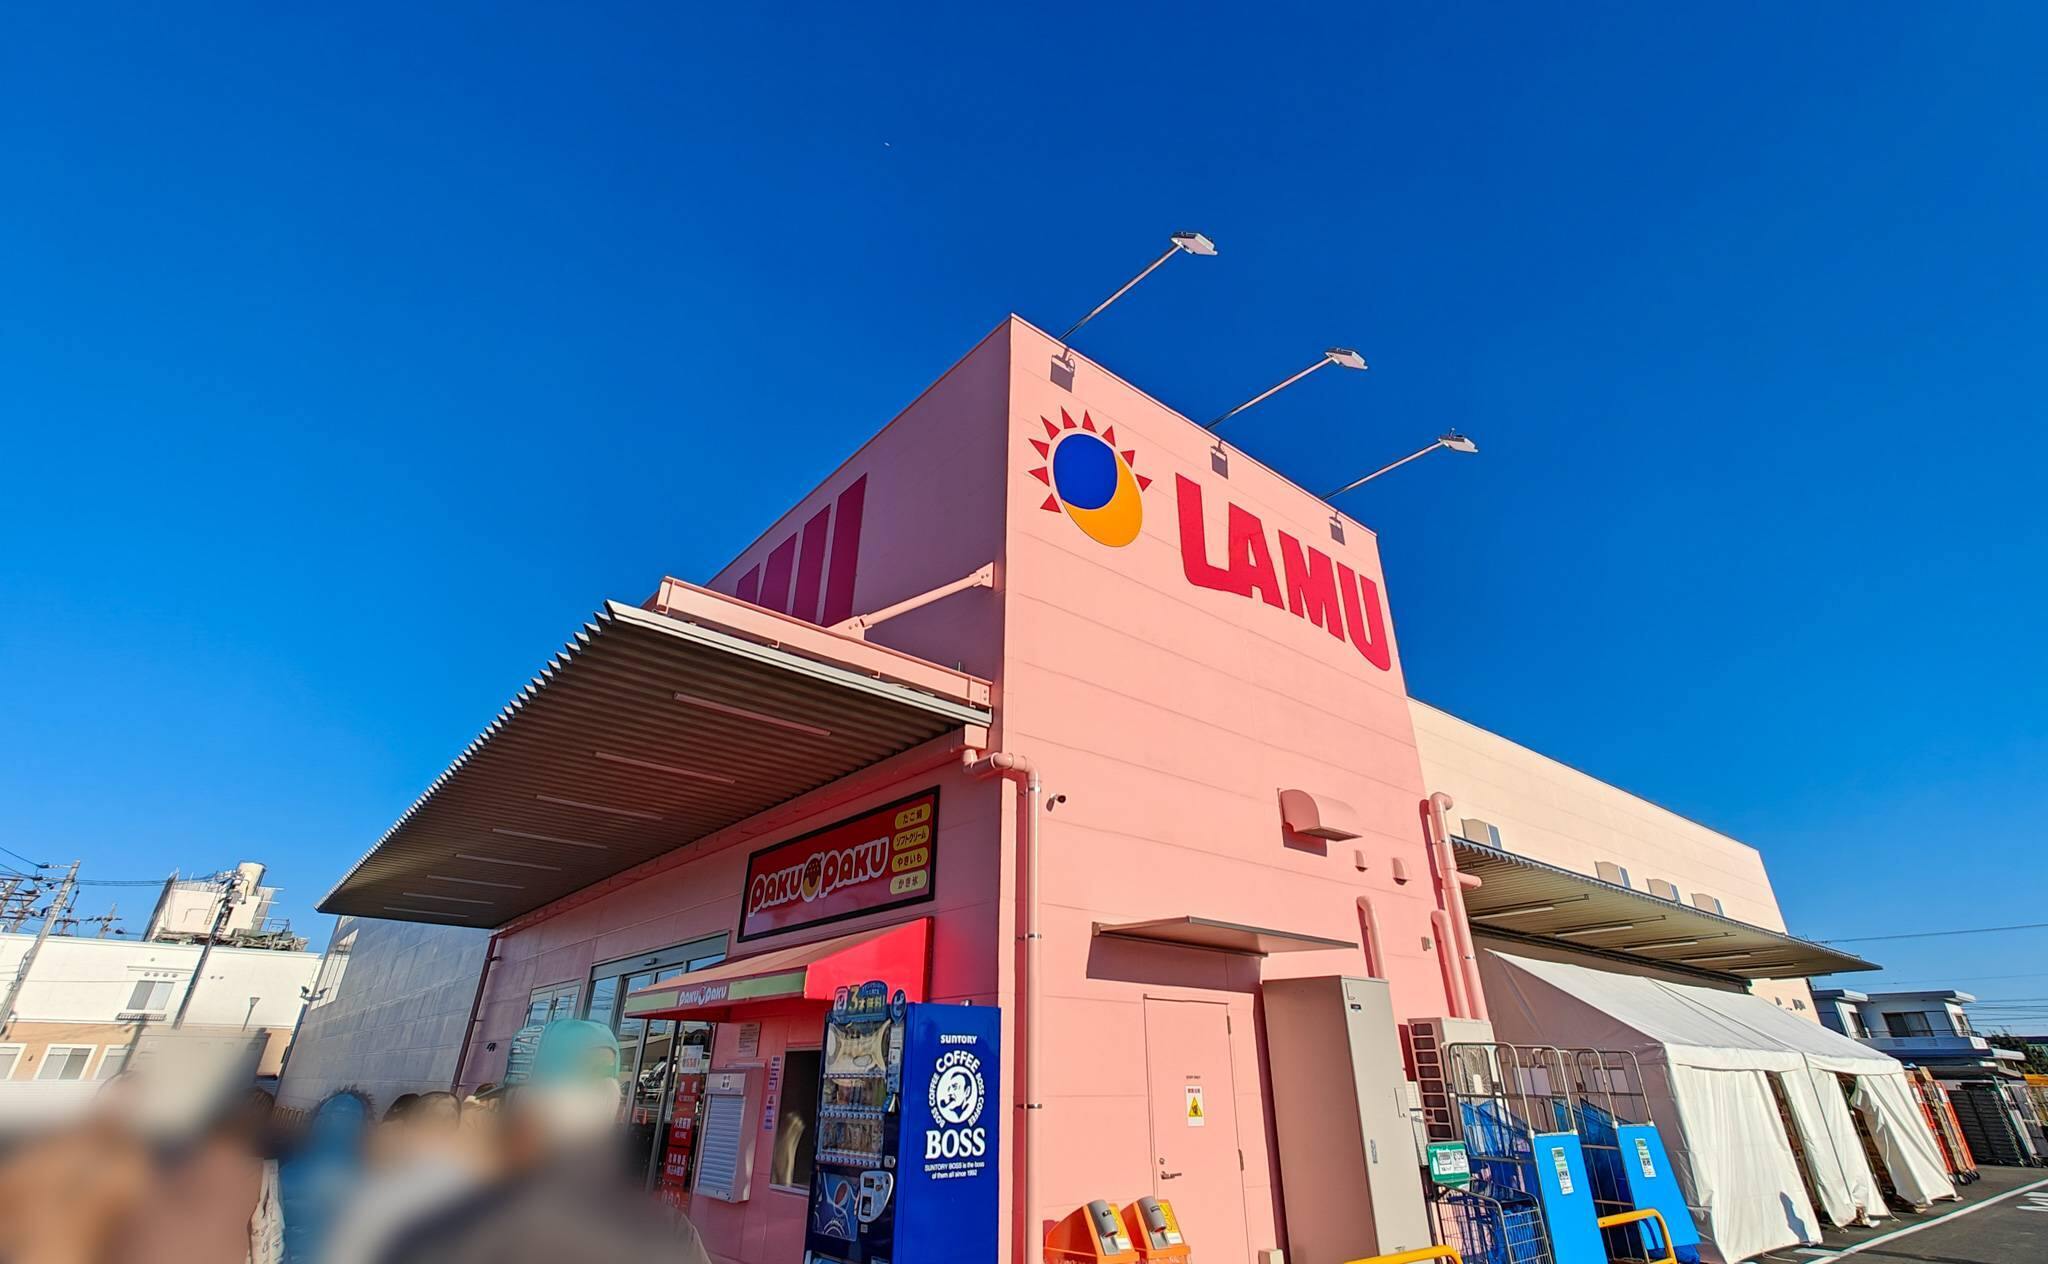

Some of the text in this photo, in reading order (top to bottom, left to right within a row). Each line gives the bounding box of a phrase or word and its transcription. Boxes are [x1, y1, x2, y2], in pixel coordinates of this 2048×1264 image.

[1175, 472, 1391, 672] LAMU
[896, 830, 926, 847] ソフトクリーム
[897, 852, 922, 868] やきいも
[748, 836, 889, 917] PAKU PAKU
[940, 1034, 978, 1045] SUNTORY
[936, 1049, 981, 1073] COFFEE
[928, 1072, 940, 1107] COFFEE
[925, 1127, 986, 1160] BOSS
